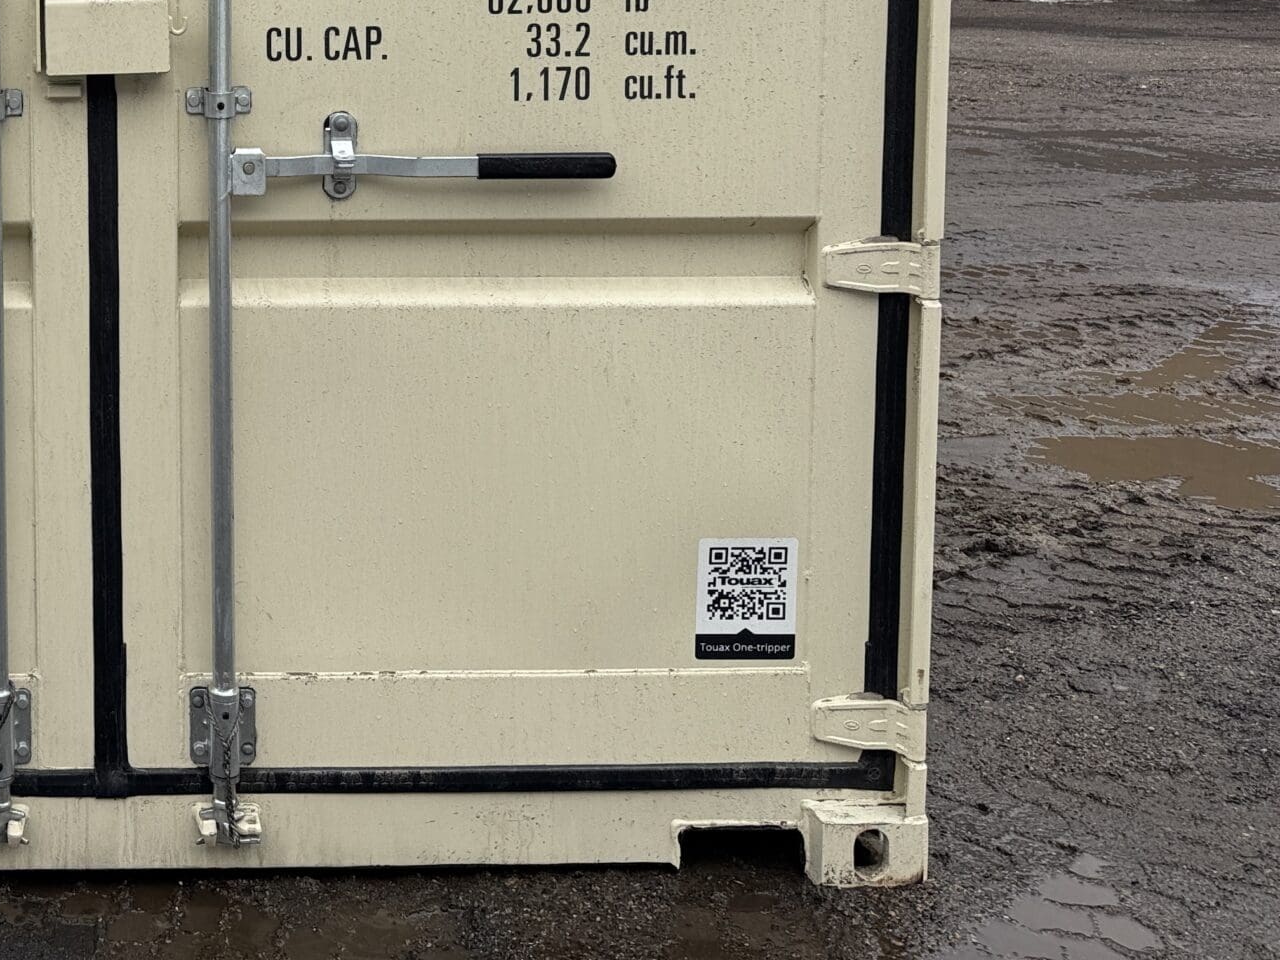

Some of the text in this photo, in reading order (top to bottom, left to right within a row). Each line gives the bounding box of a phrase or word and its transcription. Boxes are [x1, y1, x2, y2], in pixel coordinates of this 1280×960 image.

[266, 22, 696, 62] CU. CAP. 33.2 cu.m.
[510, 64, 696, 102] 1,170 cu.ft.
[718, 576, 774, 586] Touax
[700, 642, 791, 653] Touax One-tripper
